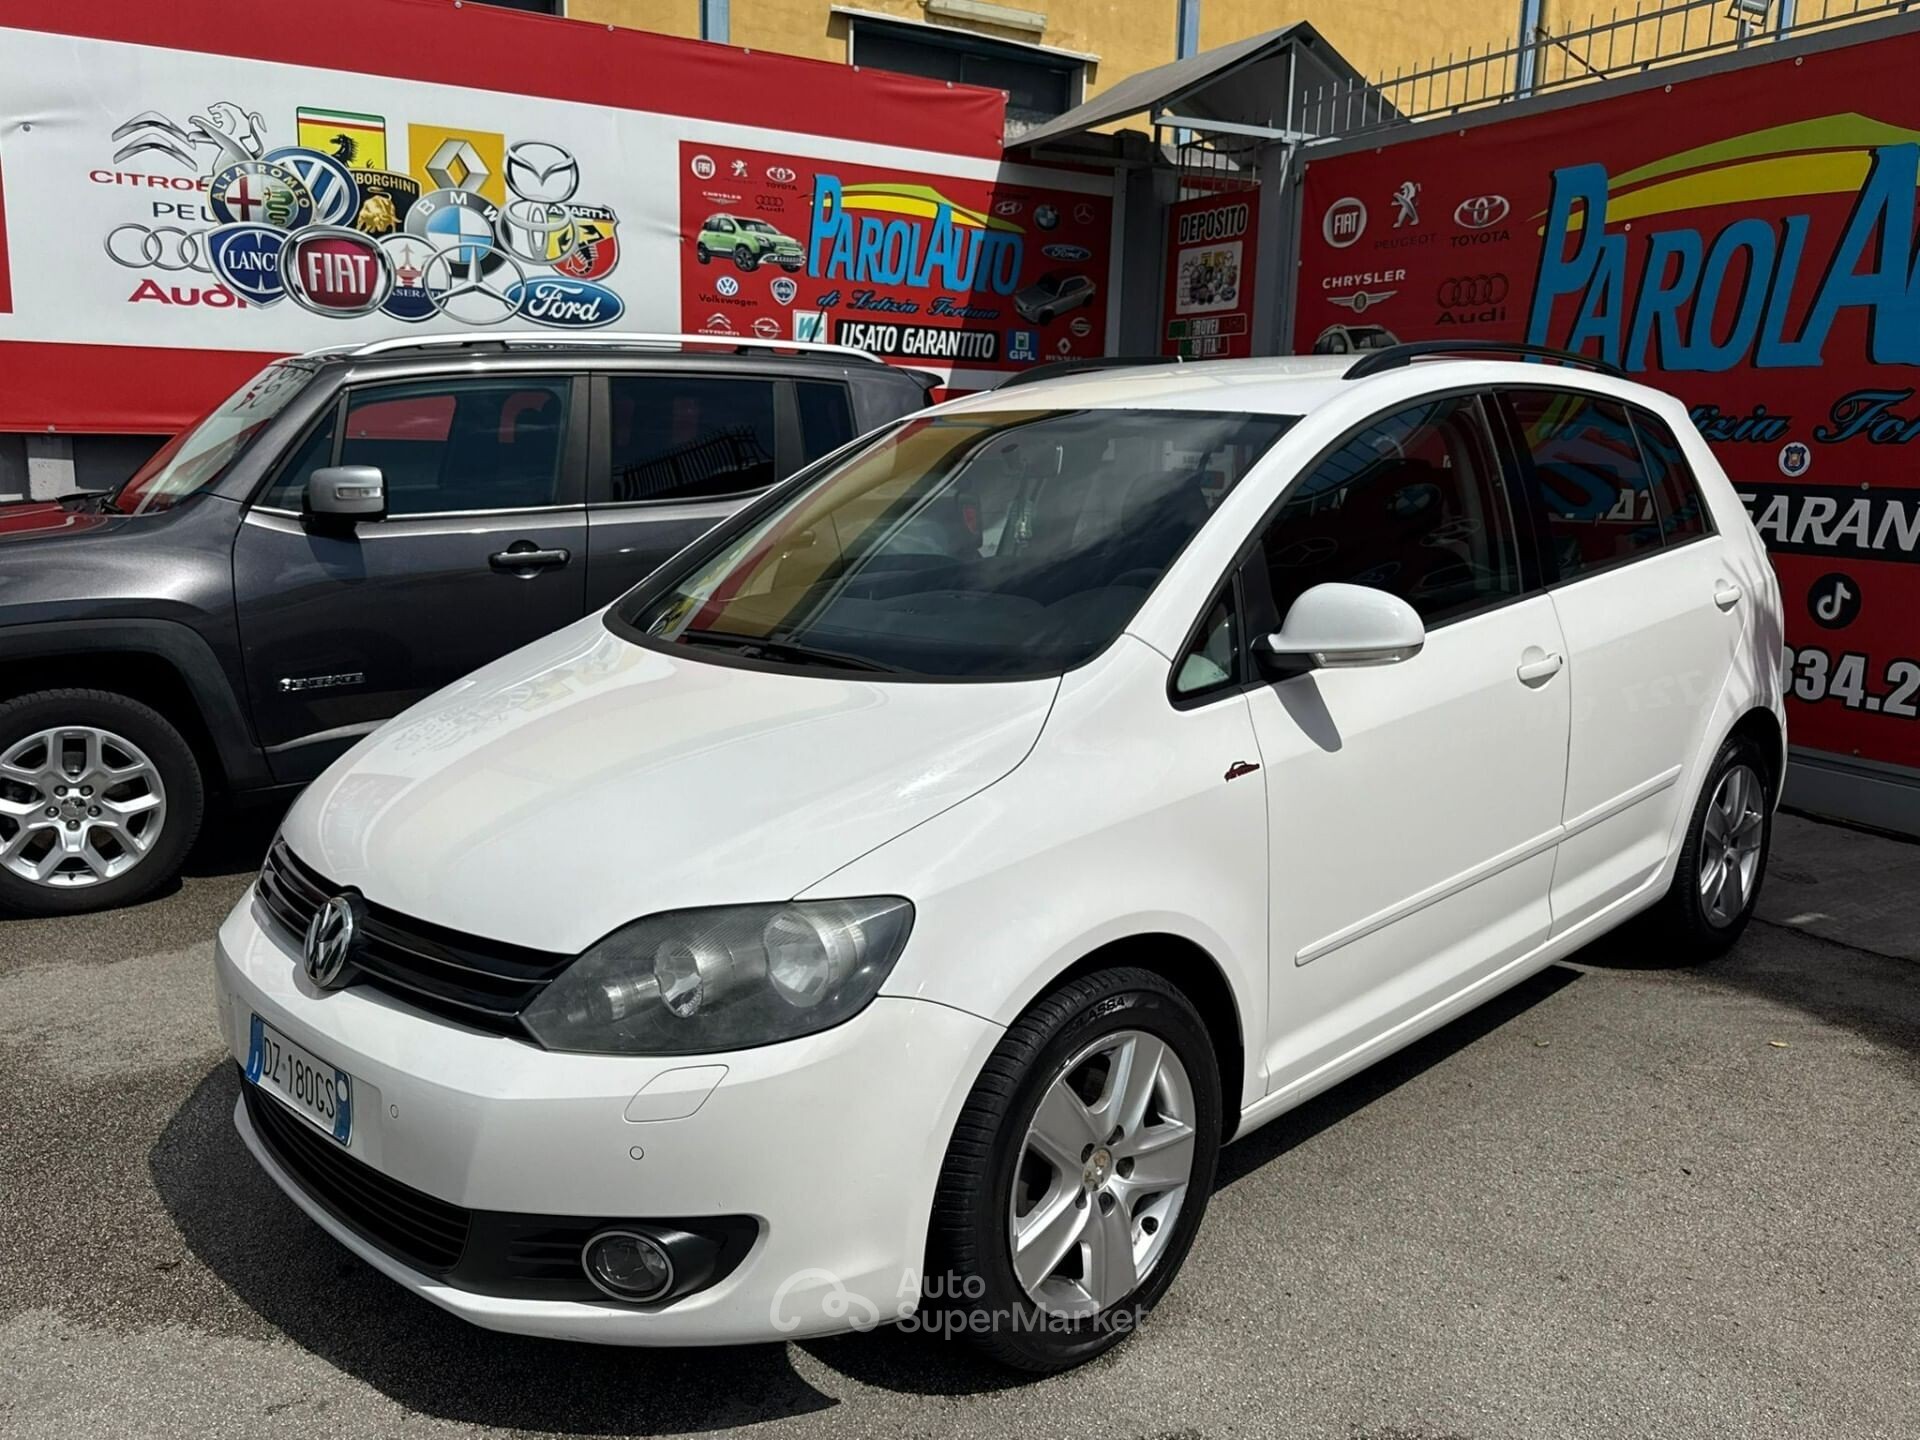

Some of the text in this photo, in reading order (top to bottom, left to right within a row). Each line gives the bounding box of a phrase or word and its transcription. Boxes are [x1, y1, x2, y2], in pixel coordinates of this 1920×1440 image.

[212, 164, 310, 209] ALFA ROMEO
[352, 172, 416, 195] BORGHINI
[766, 182, 798, 192] TOYOTA
[152, 202, 218, 223] PEU
[416, 191, 498, 222] BMW
[548, 205, 611, 219] AARTH
[1179, 205, 1247, 243] DEPOSITO
[1334, 212, 1359, 235] FIAT
[1374, 232, 1438, 250] PEUGEOT
[1451, 230, 1511, 247] TOYOTA
[228, 250, 279, 272] LANCI
[306, 251, 371, 295] FIAT
[1322, 269, 1407, 289] CHRYSLER
[528, 282, 601, 322] Ford
[698, 293, 759, 308] Volkswagen
[816, 289, 841, 308] di
[1435, 308, 1506, 326] Audi
[840, 322, 898, 353] USATO
[902, 326, 996, 359] GARANTITO
[1009, 350, 1036, 361] GPL
[1813, 387, 1920, 444] For
[1739, 493, 1920, 551] ARAN
